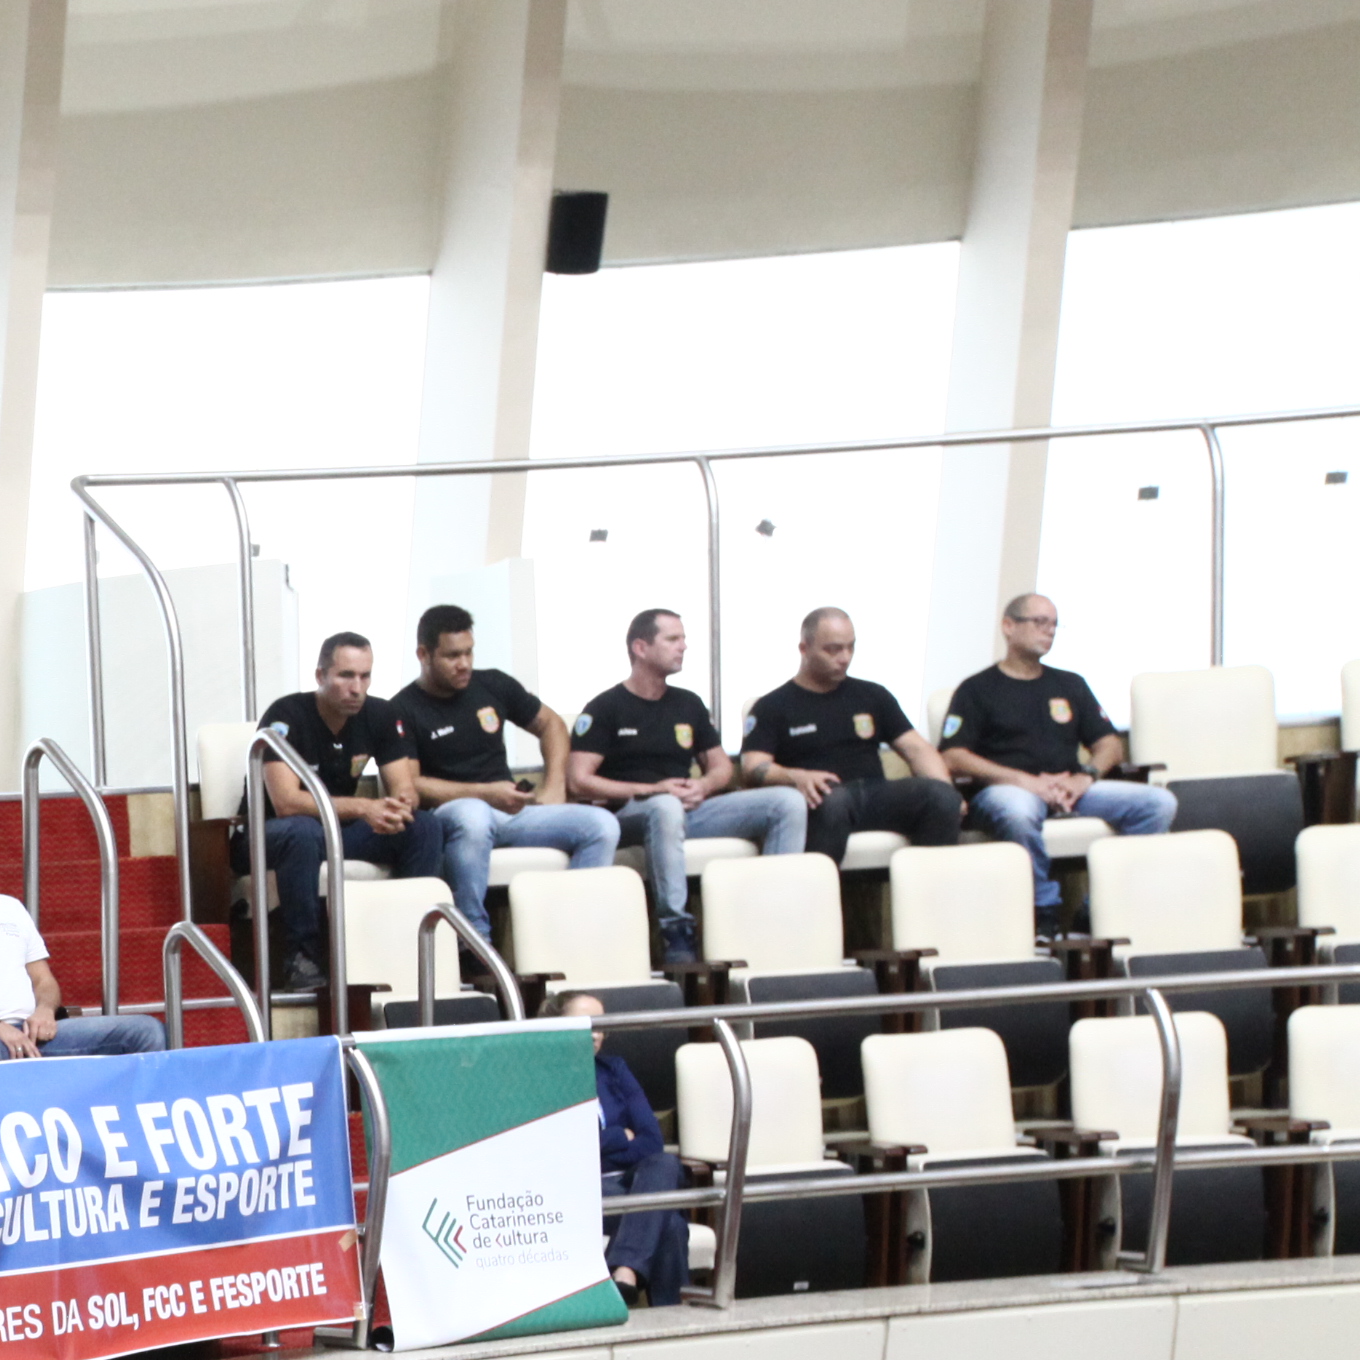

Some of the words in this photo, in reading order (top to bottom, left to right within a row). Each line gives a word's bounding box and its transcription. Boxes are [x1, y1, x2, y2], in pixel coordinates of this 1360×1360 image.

[90, 1105, 138, 1179] E
[135, 1081, 314, 1174] FORTE
[139, 1180, 164, 1228] E
[172, 1160, 316, 1225] ESPORTE
[466, 1190, 544, 1212] Fundação
[469, 1210, 564, 1231] Catarinense
[472, 1232, 492, 1249] de
[475, 1252, 516, 1271] quatro
[518, 1248, 570, 1265] décadas
[51, 1298, 85, 1336] DA
[87, 1292, 140, 1331] SOL,
[143, 1283, 185, 1322] FCC
[190, 1280, 207, 1314] E
[210, 1262, 328, 1311] FESPORTE
